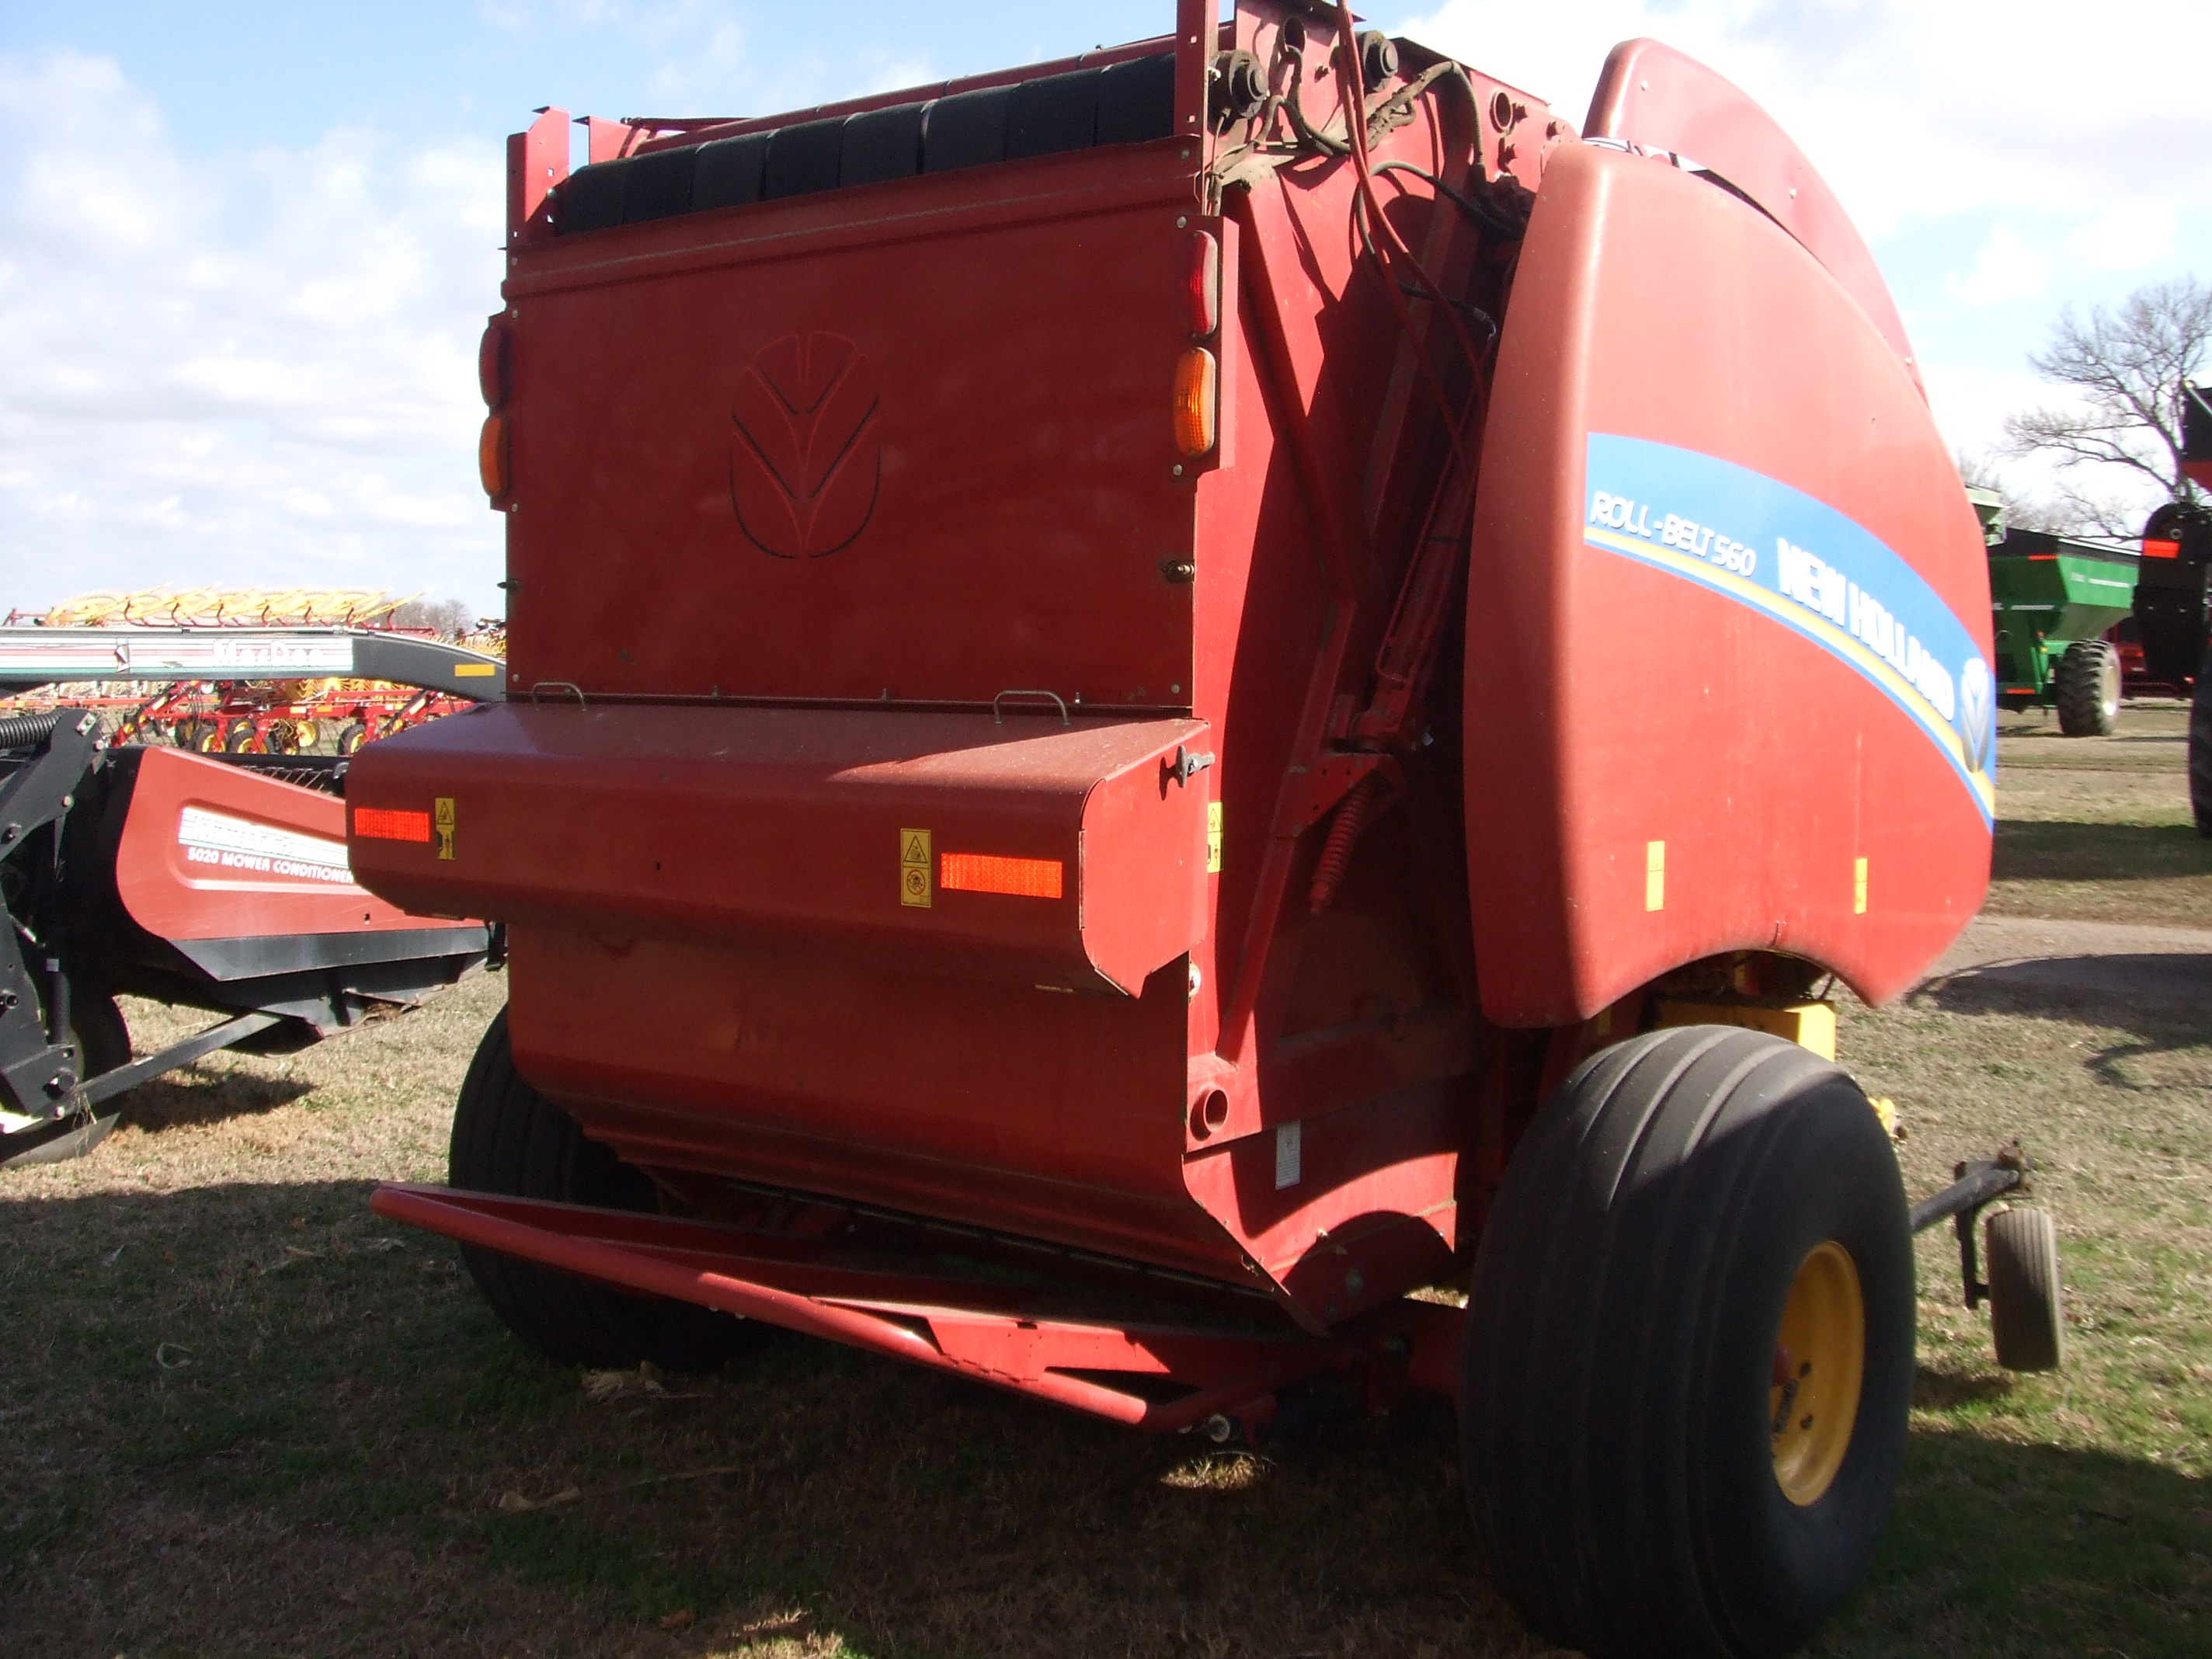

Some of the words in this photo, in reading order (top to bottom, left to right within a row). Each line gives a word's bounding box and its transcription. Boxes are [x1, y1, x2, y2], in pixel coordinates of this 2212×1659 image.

[1711, 534, 1757, 577] 560
[1777, 537, 1847, 628] NEW
[1849, 582, 1955, 722] HOLLAND
[187, 847, 220, 864] 5020
[221, 852, 270, 872] MOWER
